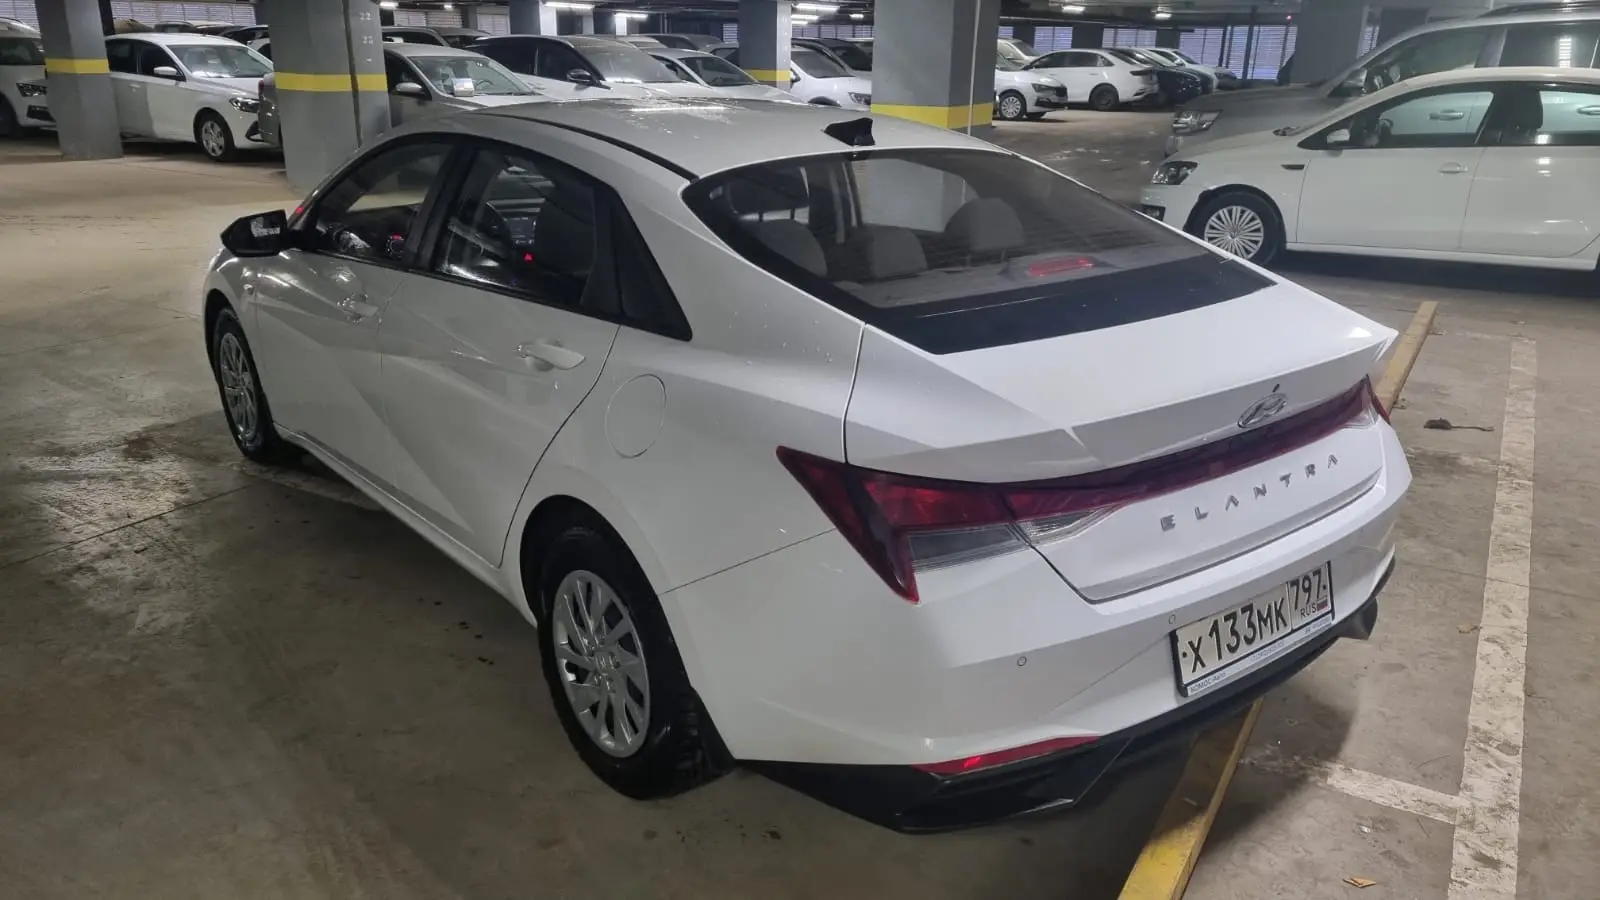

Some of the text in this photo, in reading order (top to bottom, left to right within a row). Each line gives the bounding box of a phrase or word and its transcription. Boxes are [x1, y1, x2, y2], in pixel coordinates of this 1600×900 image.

[1160, 454, 1338, 531] ELANTRA
[1290, 568, 1321, 610] 797
[1300, 603, 1317, 617] RUS
